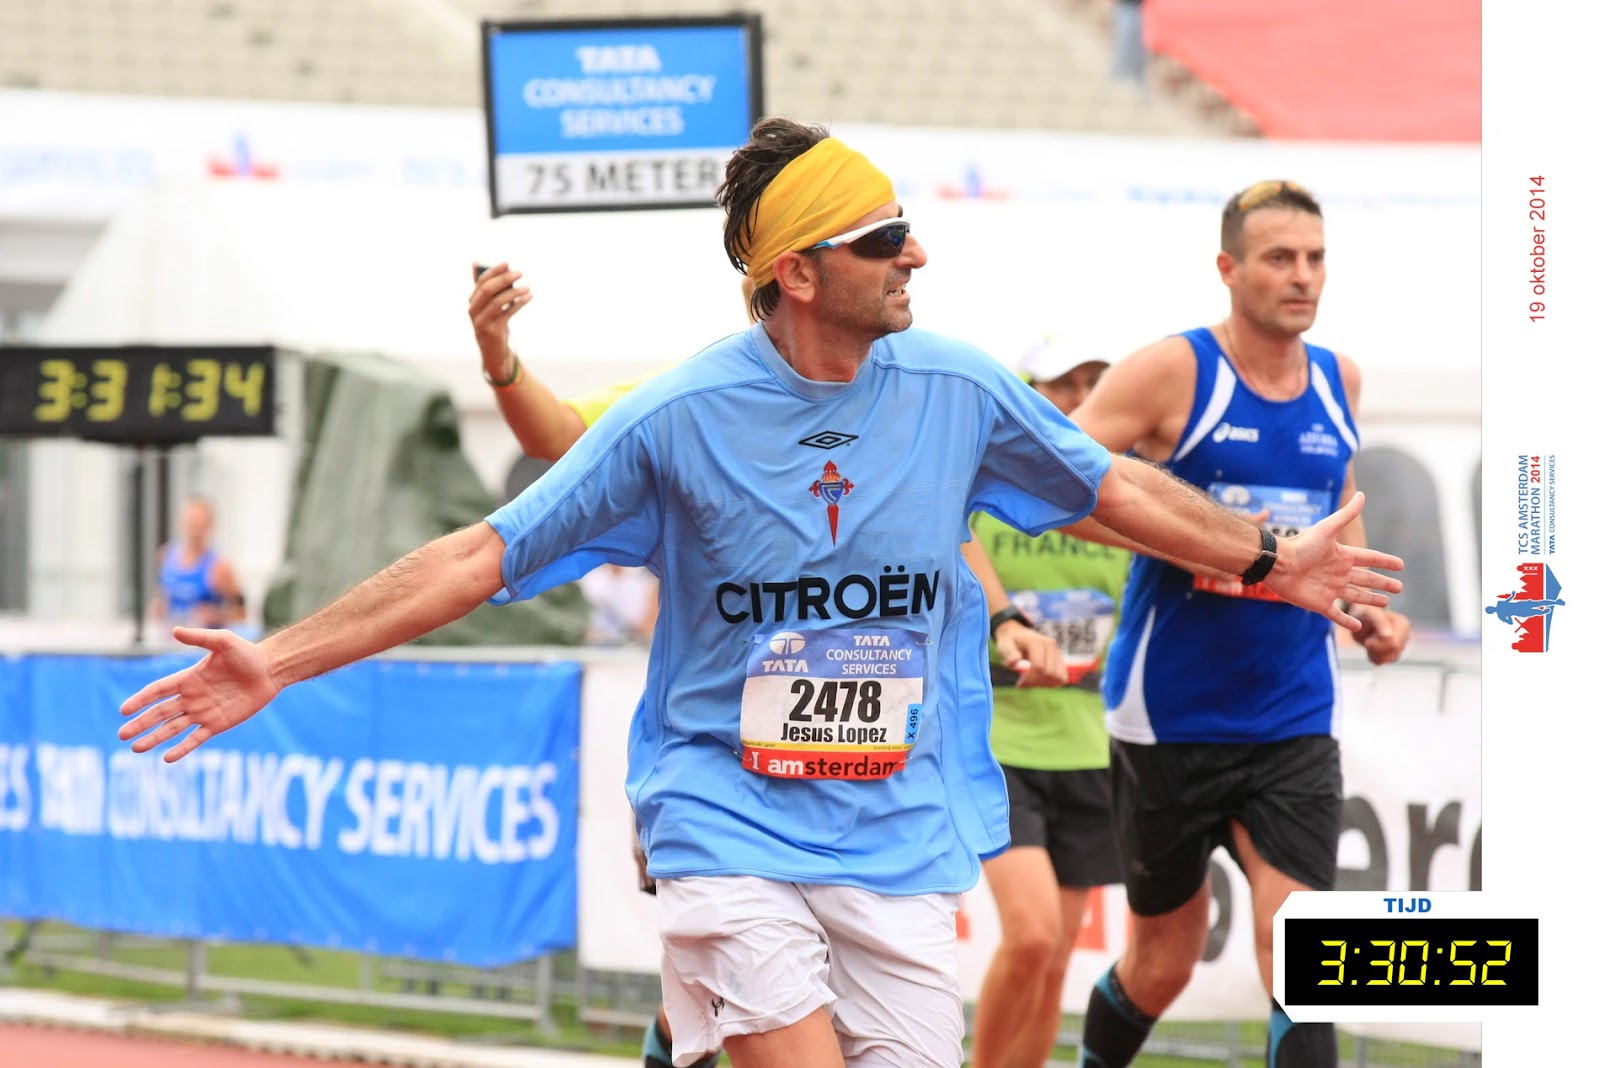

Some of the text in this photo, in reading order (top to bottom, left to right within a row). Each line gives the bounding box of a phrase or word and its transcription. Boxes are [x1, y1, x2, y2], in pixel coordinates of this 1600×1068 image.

[576, 44, 662, 73] TATA
[523, 74, 716, 108] CONSULTANCY
[560, 105, 685, 139] SERVICES
[525, 163, 572, 197] 75
[587, 157, 721, 194] METER
[716, 565, 940, 624] CITROËN
[853, 635, 890, 646] TATA
[762, 659, 809, 673] TATA
[826, 649, 912, 661] CONSULTANCY
[842, 664, 897, 675] SERVICES
[789, 679, 882, 723] 2478
[909, 708, 919, 728] 496
[781, 723, 887, 745] Jesus Lopez
[751, 751, 759, 770] I
[108, 748, 345, 850] CONSULTANCY
[338, 758, 558, 864] SERVICES
